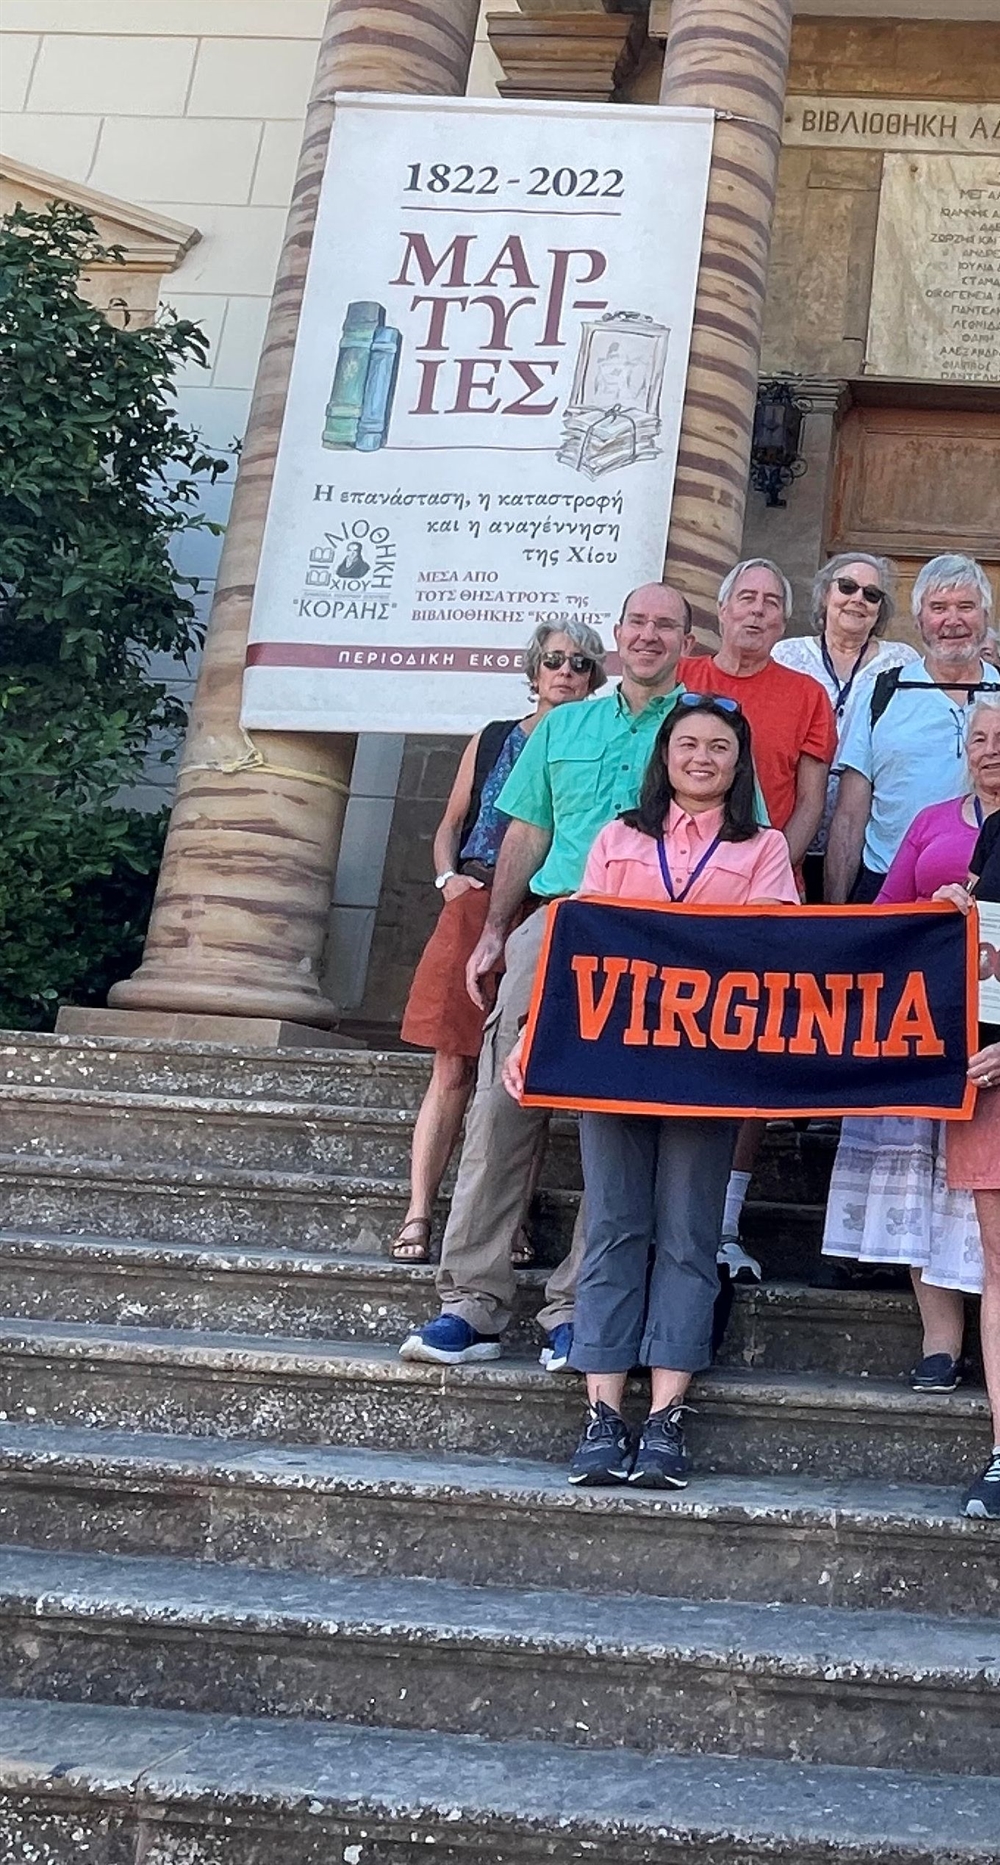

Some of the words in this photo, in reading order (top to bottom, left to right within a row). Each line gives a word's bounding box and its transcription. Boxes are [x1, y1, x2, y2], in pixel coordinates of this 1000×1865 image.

[801, 110, 957, 139] ΒΙΒΛΙΟΘΗΚΗ
[313, 484, 335, 502] Η
[498, 490, 624, 514] καταστροφή
[427, 519, 460, 533] και
[489, 515, 620, 542] αναγέννηση
[522, 547, 560, 567] της
[566, 545, 618, 564] Χίου
[338, 649, 455, 666] ΠΕΡΙΟΔΙΚΗ
[571, 955, 945, 1057] VIRGINIA
